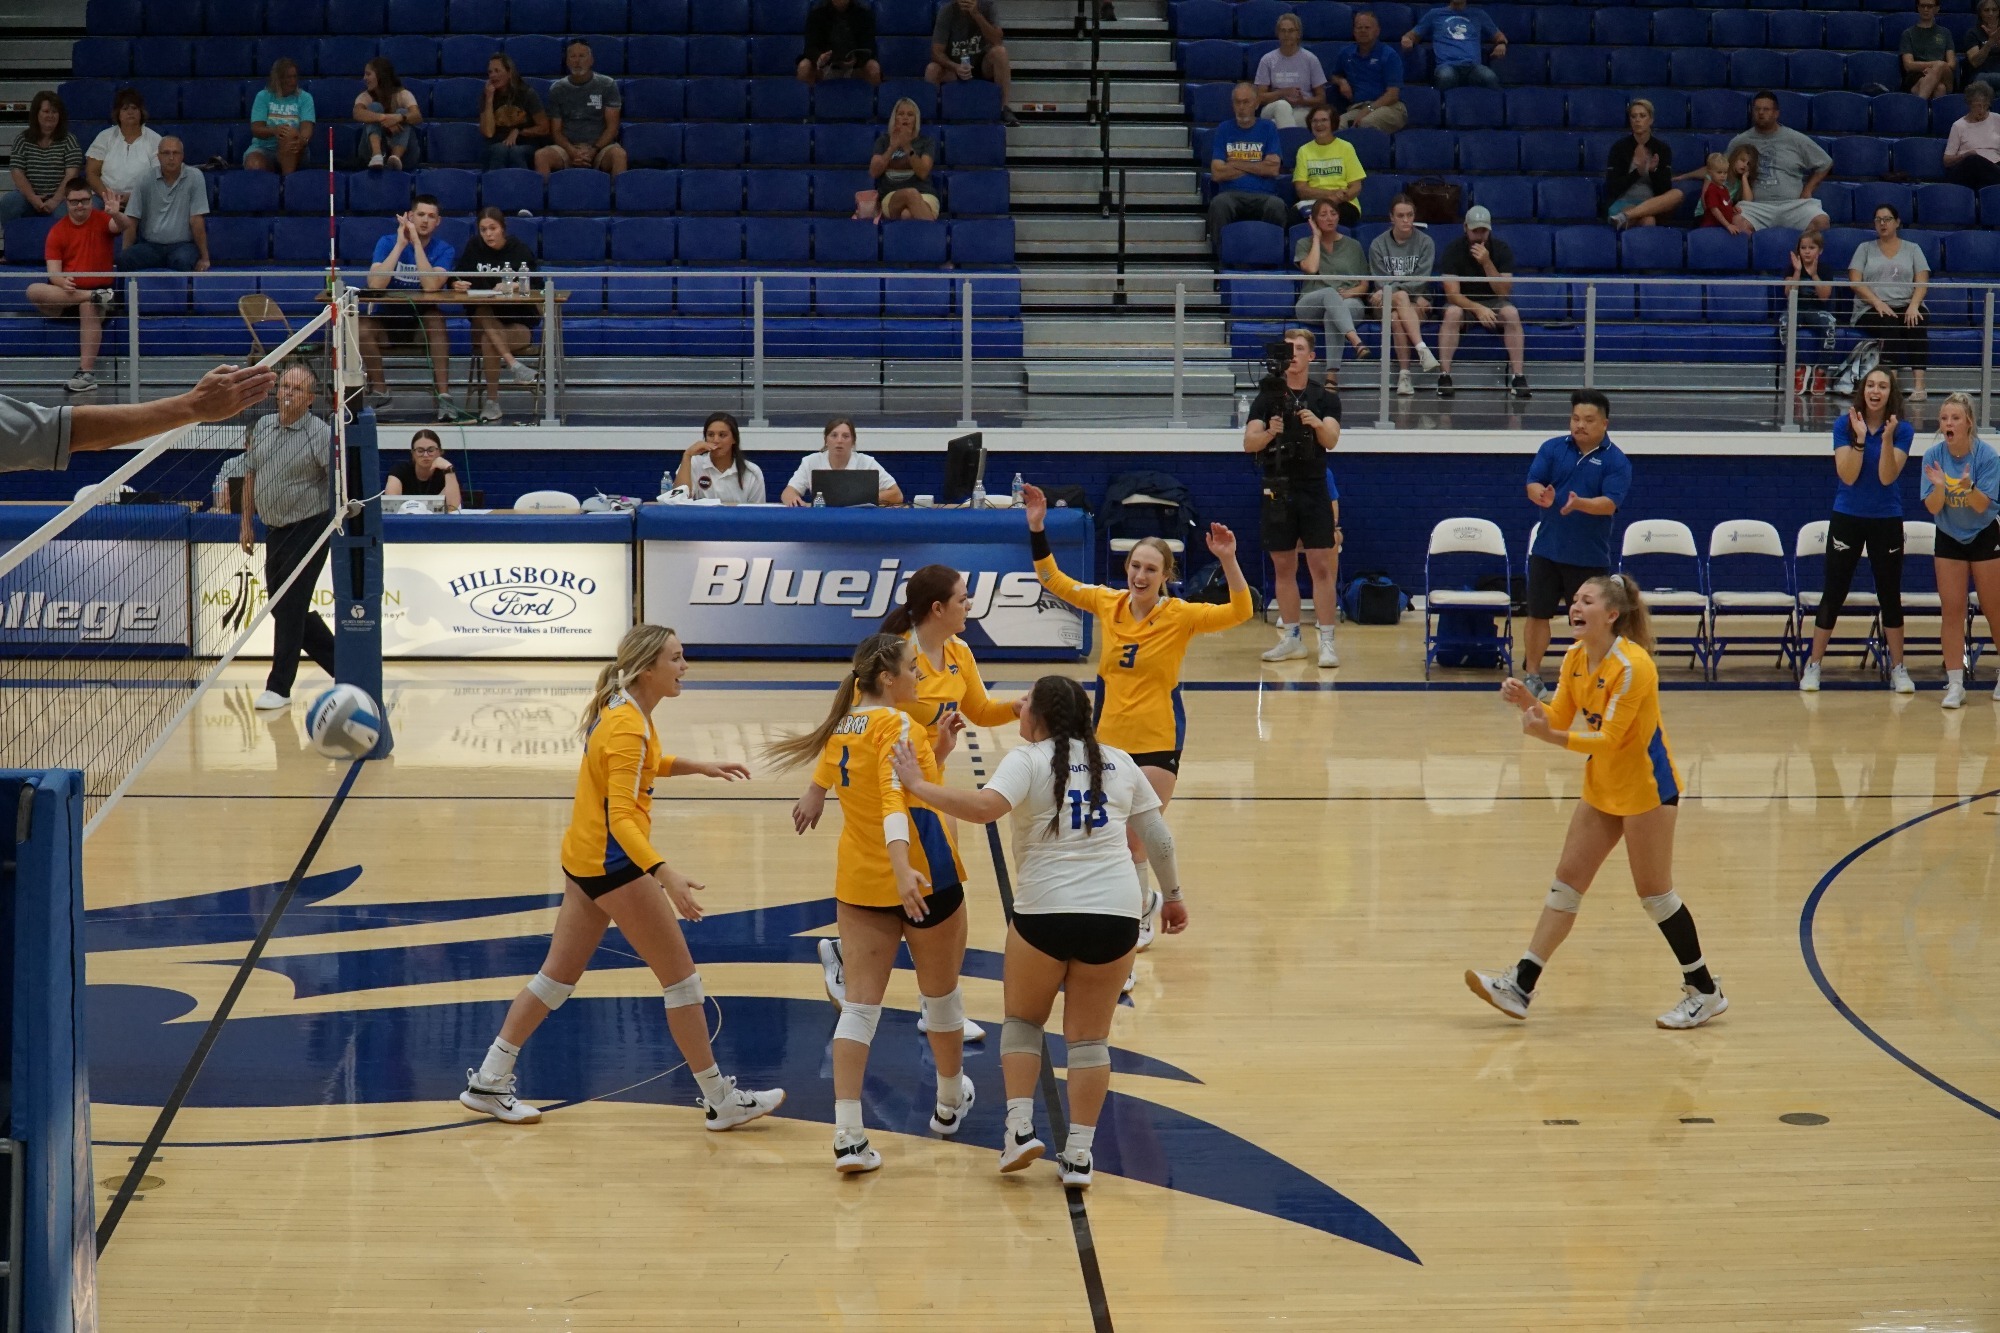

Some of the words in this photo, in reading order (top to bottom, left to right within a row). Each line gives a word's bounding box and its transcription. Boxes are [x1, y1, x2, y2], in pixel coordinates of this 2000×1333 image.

[1226, 143, 1263, 152] BLUEJAY
[448, 566, 597, 597] HILLSBORO
[0, 591, 161, 640] llege
[492, 590, 555, 616] Ford
[452, 626, 480, 634] Where
[482, 626, 511, 634] Service
[514, 626, 541, 634] Makes
[550, 626, 592, 634] Difference
[1119, 643, 1140, 669] 3
[832, 714, 869, 735] ABOR
[839, 745, 850, 786] 1
